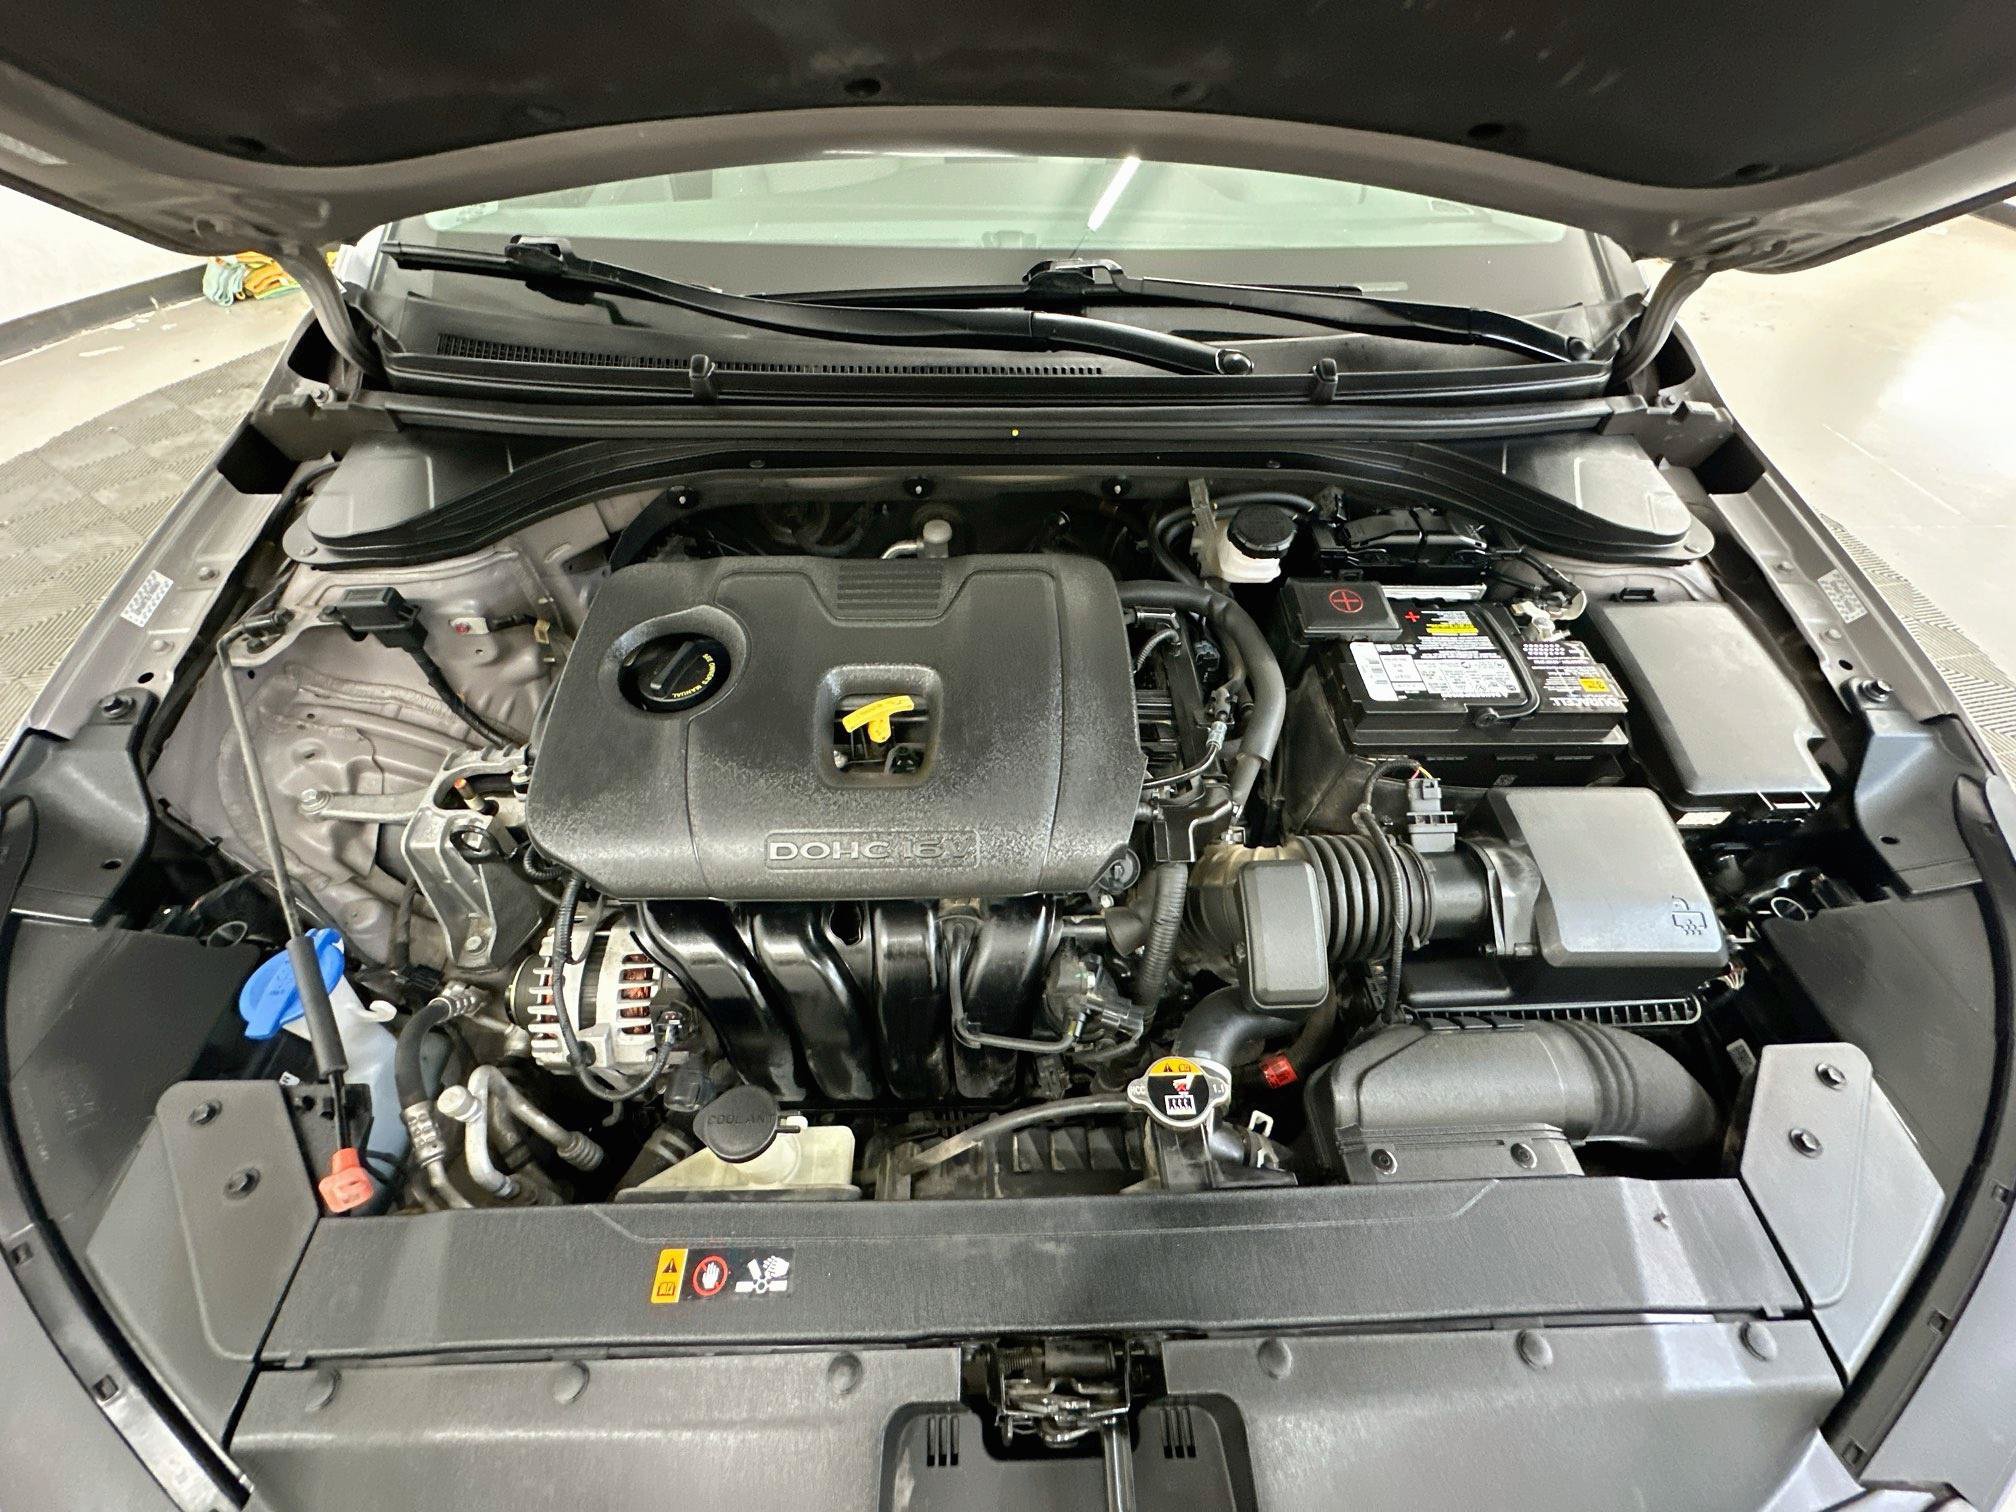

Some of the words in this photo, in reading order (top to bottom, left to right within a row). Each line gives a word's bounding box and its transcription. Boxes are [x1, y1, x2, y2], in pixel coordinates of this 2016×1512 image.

[672, 684, 702, 698] MANUAL
[1549, 697, 1620, 707] DURACELL
[769, 841, 891, 860] DOHC
[707, 1112, 777, 1125] COOLANT
